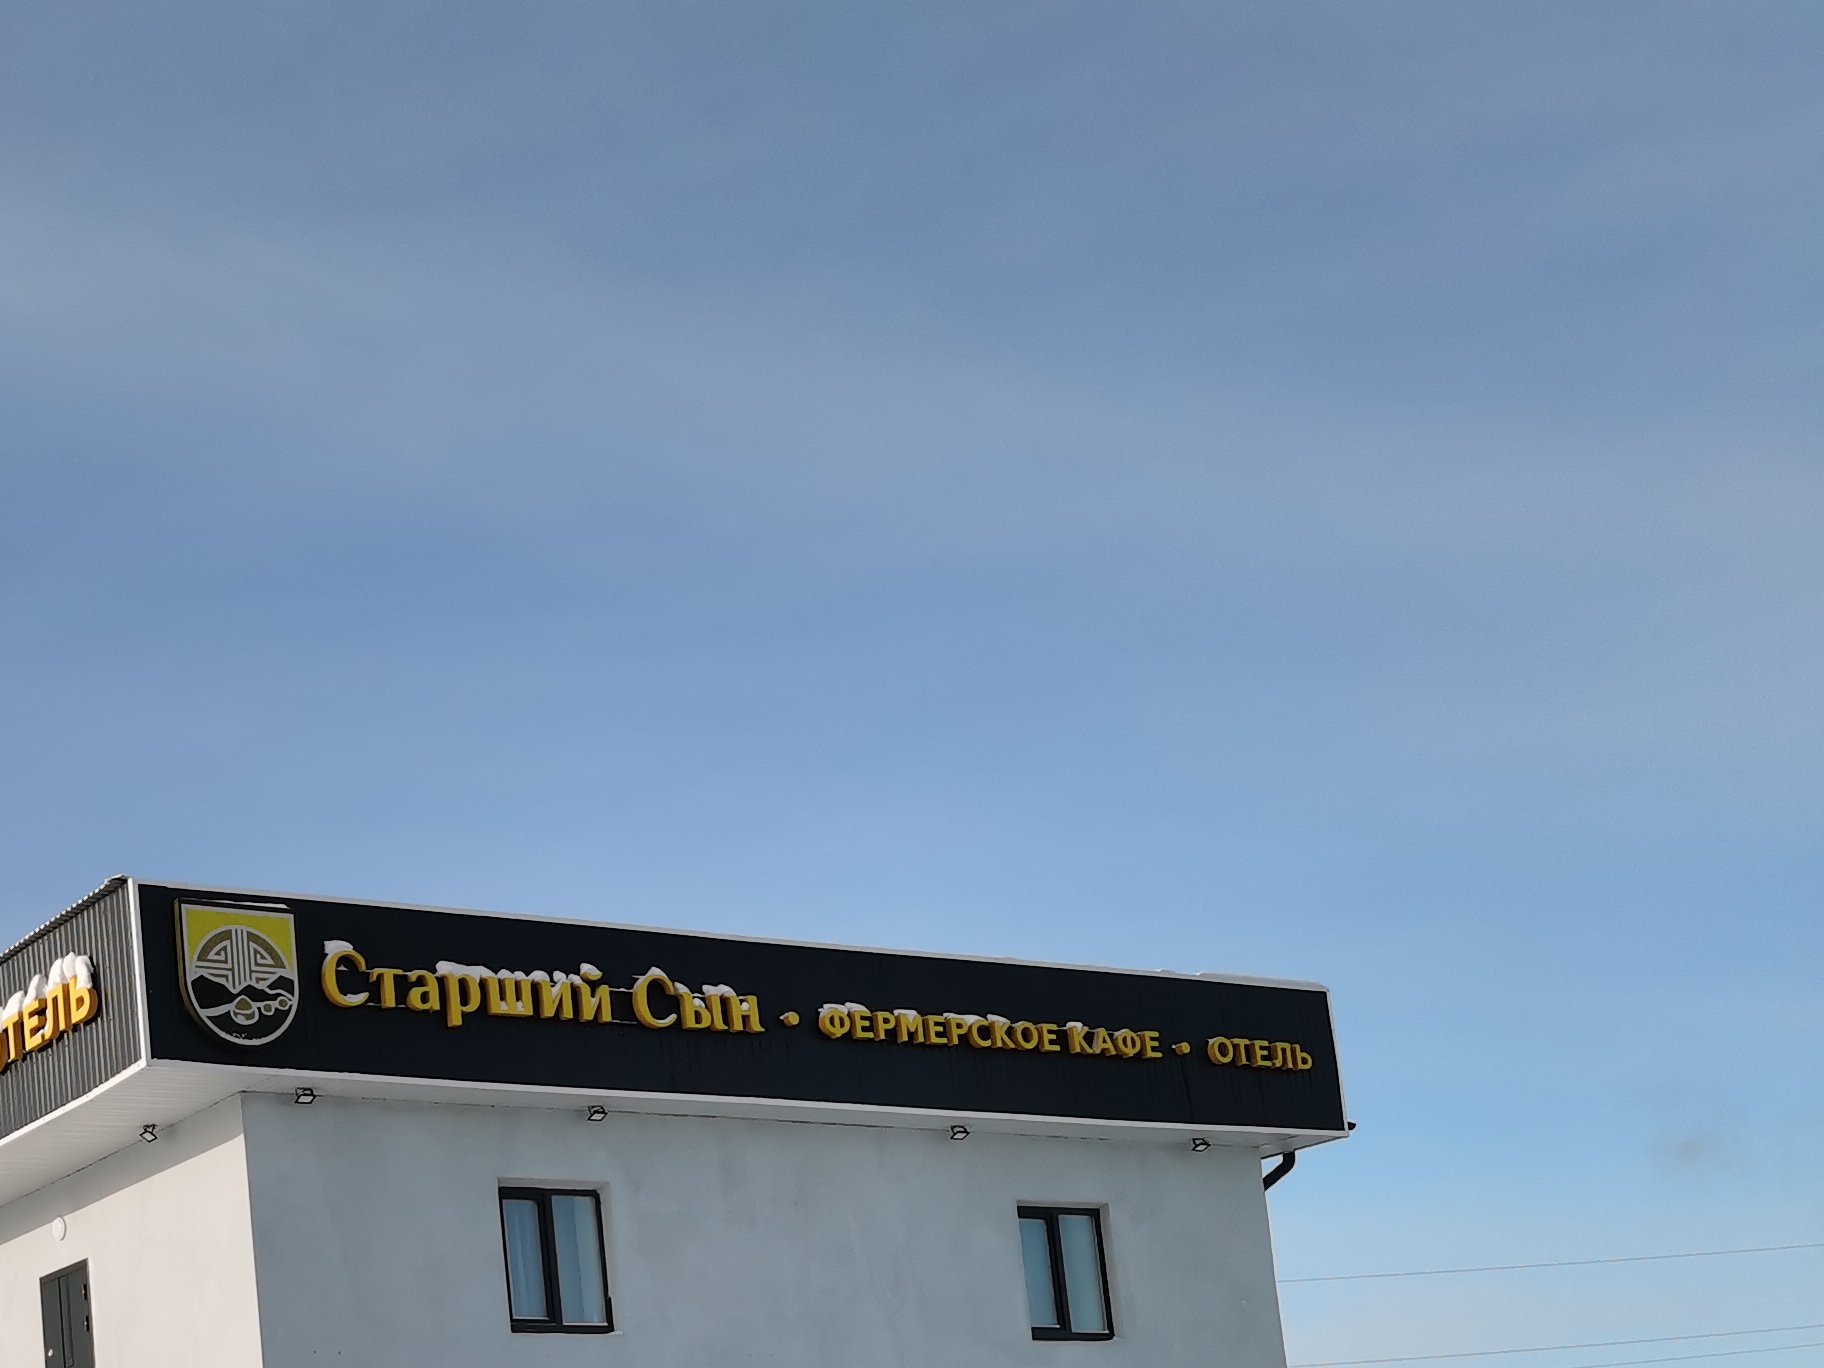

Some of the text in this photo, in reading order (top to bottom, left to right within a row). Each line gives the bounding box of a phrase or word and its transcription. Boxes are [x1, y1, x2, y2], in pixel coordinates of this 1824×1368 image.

[321, 949, 1313, 1070] Старший Сын ФЕРМЕРСКОЕ КАФЕ ОТЕЛЬ
